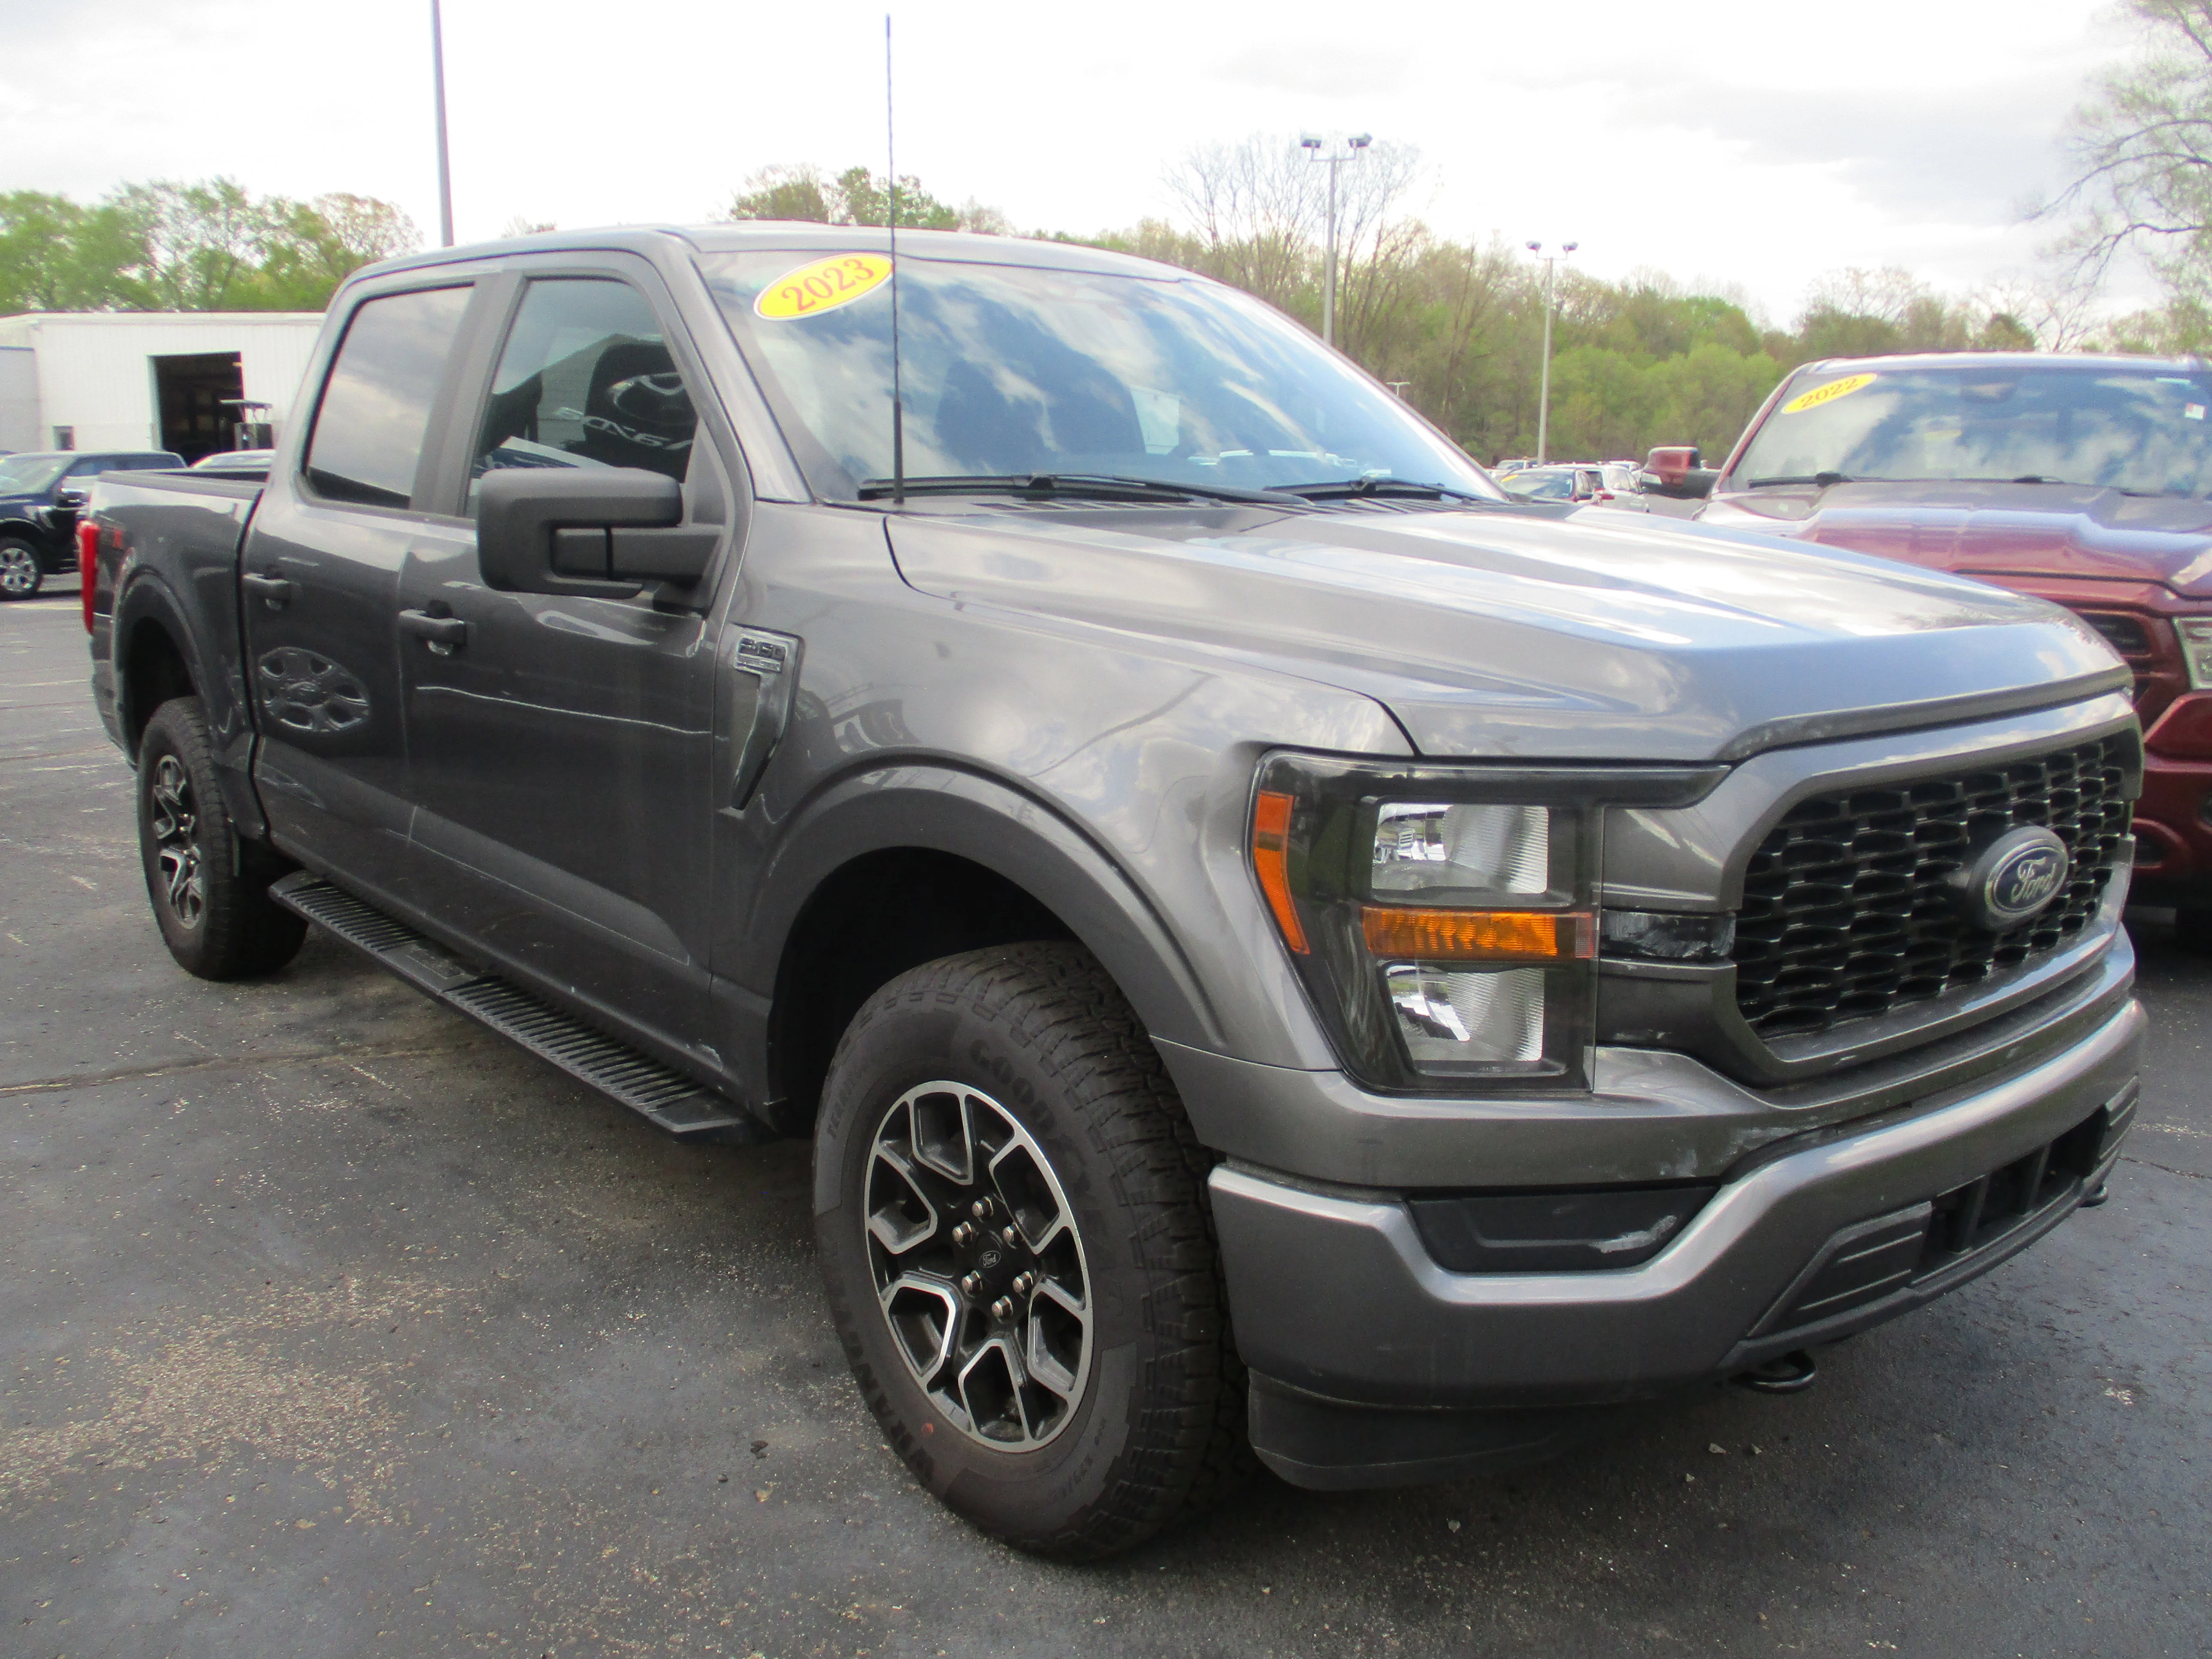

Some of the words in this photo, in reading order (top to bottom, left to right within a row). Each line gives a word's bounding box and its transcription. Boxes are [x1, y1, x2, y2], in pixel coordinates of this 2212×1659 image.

[782, 259, 874, 310] 2023
[1801, 378, 1858, 408] 2022
[2011, 856, 2056, 903] Ford
[982, 1253, 997, 1266] Ford
